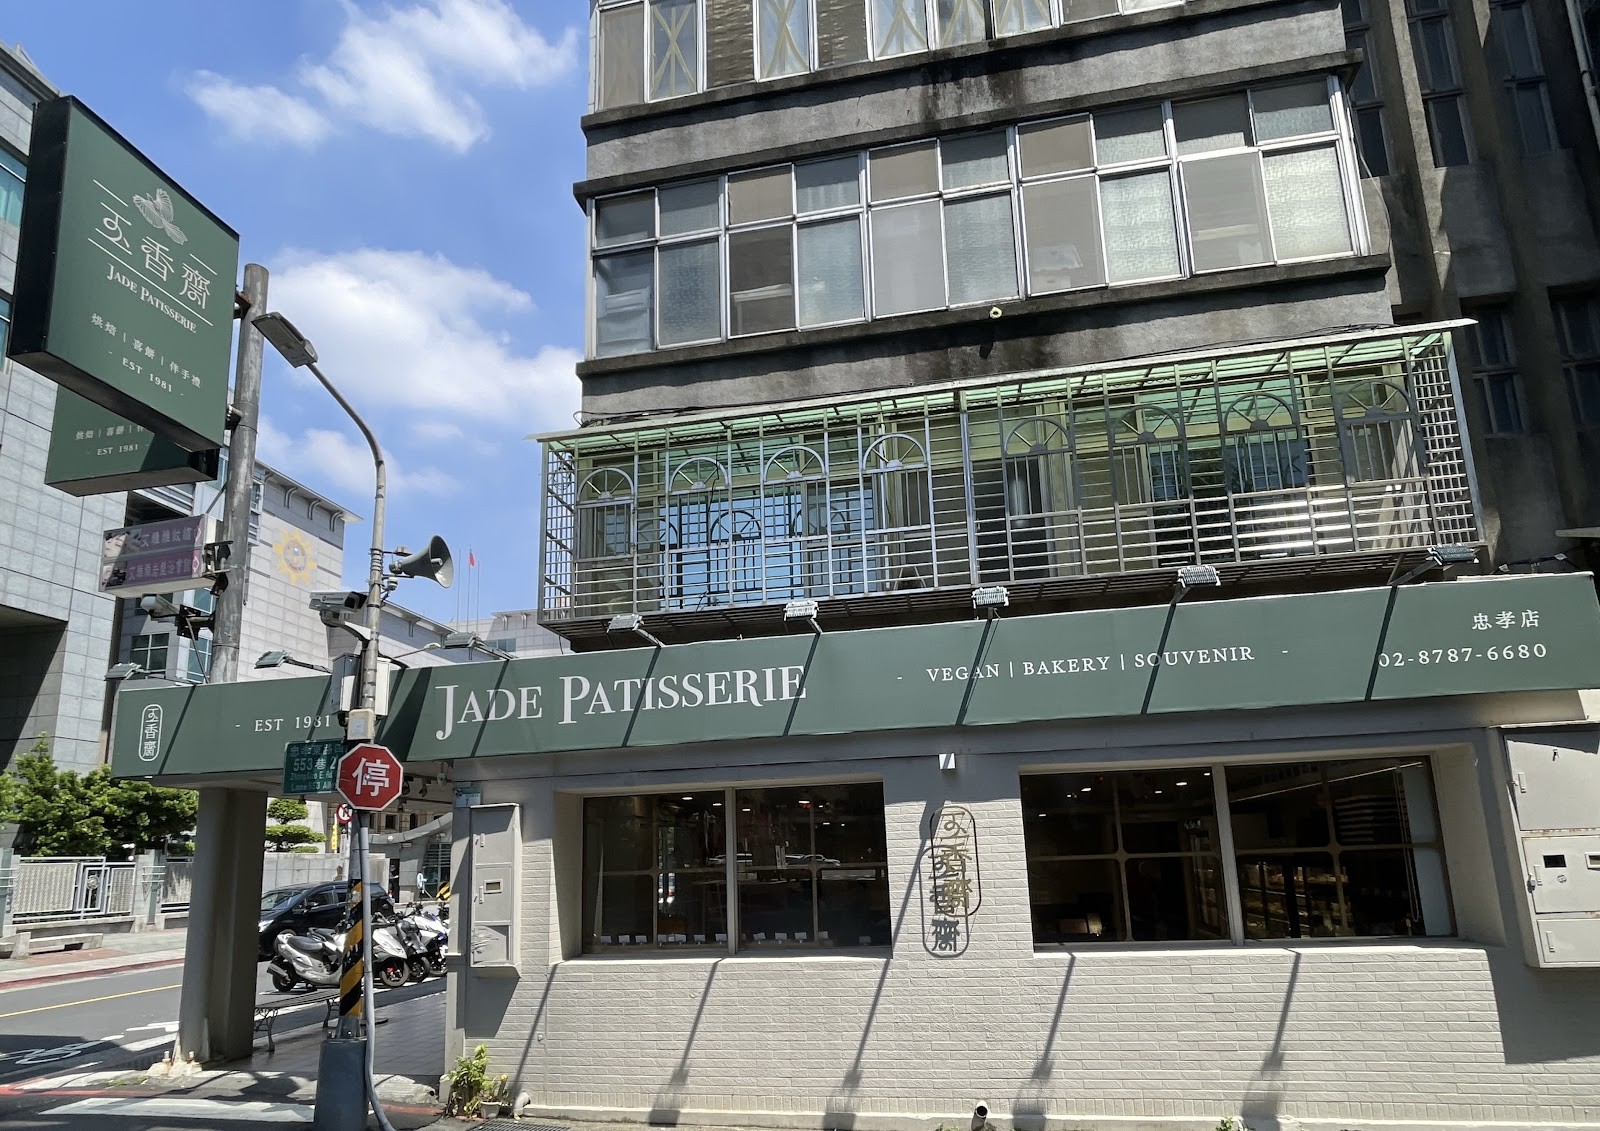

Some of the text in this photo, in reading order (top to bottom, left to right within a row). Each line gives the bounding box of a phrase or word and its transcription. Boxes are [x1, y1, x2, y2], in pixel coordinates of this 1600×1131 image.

[122, 357, 173, 393] EST 1981
[169, 360, 201, 388] 伴手禮
[97, 443, 139, 456] EST 1981
[1471, 609, 1540, 631] 忠孝店
[926, 646, 1255, 683] VEGAN BAKERY SOUVENIR
[1377, 643, 1547, 668] 02-8787-6680
[254, 714, 331, 732] EST 1981
[352, 757, 390, 797] 停
